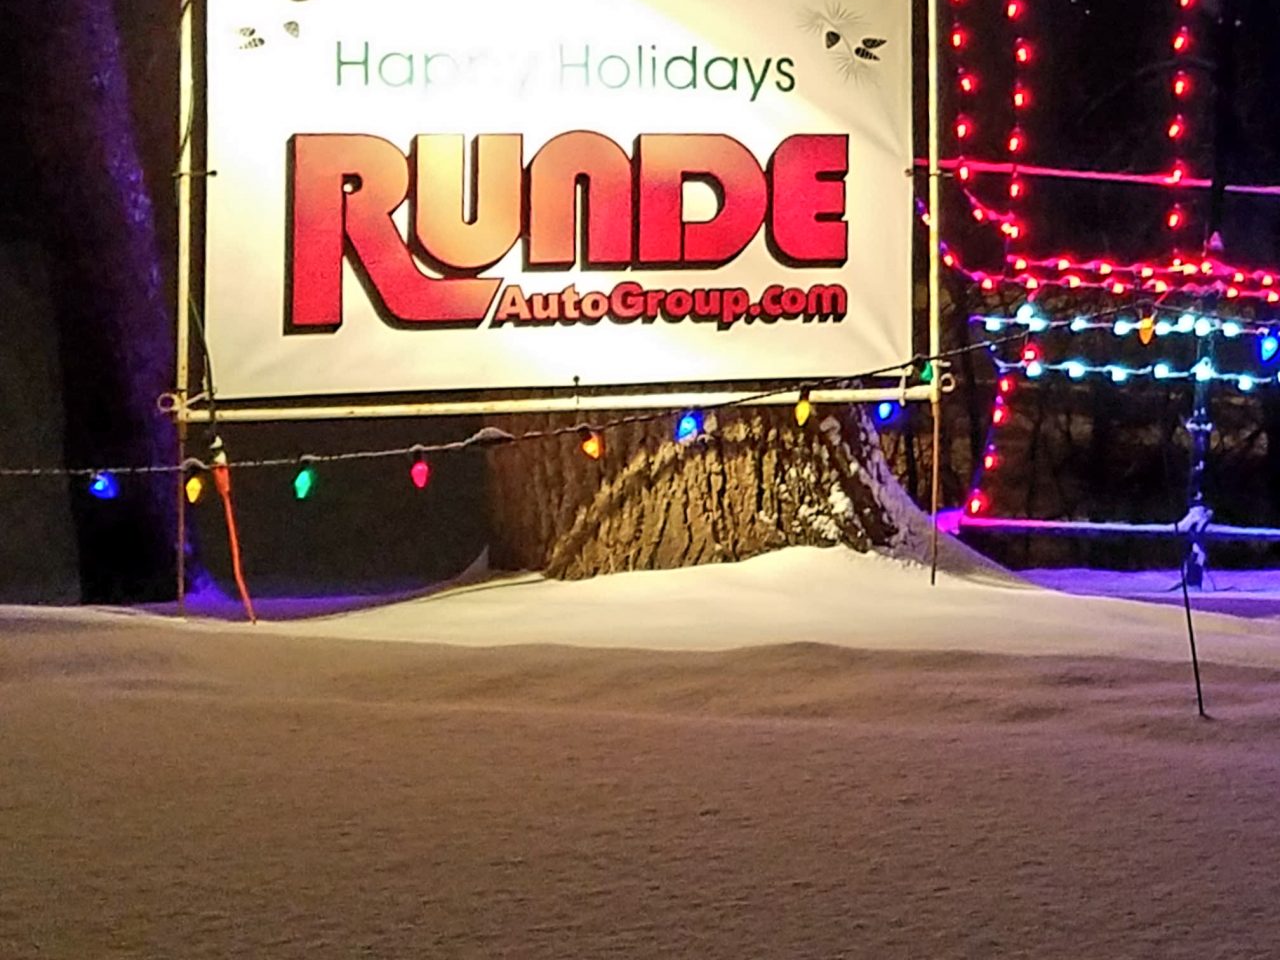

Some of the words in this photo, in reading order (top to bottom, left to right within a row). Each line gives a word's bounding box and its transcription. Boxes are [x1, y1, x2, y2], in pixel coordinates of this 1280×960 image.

[335, 40, 534, 102] Hap
[559, 41, 796, 101] Holidays
[284, 130, 850, 334] RUNDE
[489, 281, 848, 331] AutoGroup.com
